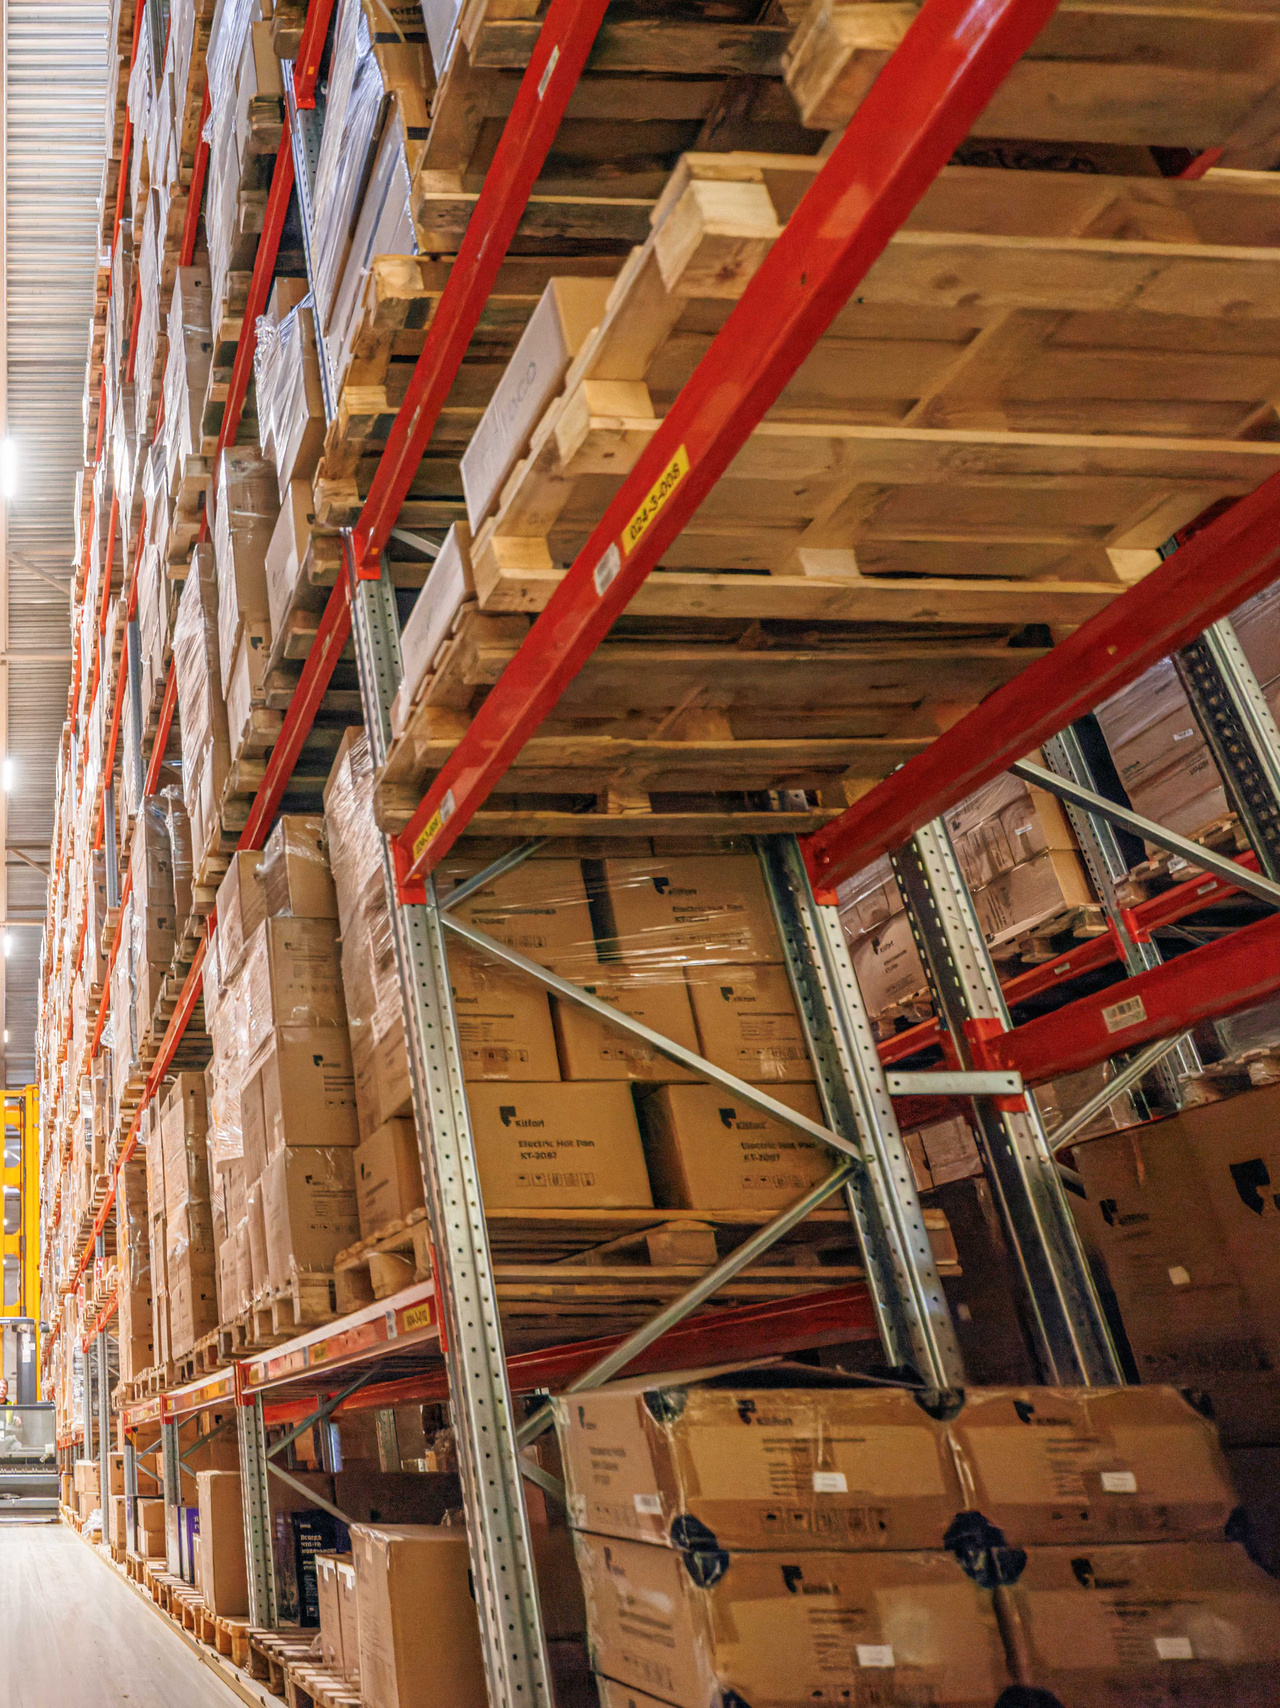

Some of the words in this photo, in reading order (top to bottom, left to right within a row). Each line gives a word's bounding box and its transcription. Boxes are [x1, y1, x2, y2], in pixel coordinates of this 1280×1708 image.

[629, 462, 681, 541] 024-3-008
[515, 1119, 545, 1128] Kitfort
[518, 1140, 554, 1148] Electric
